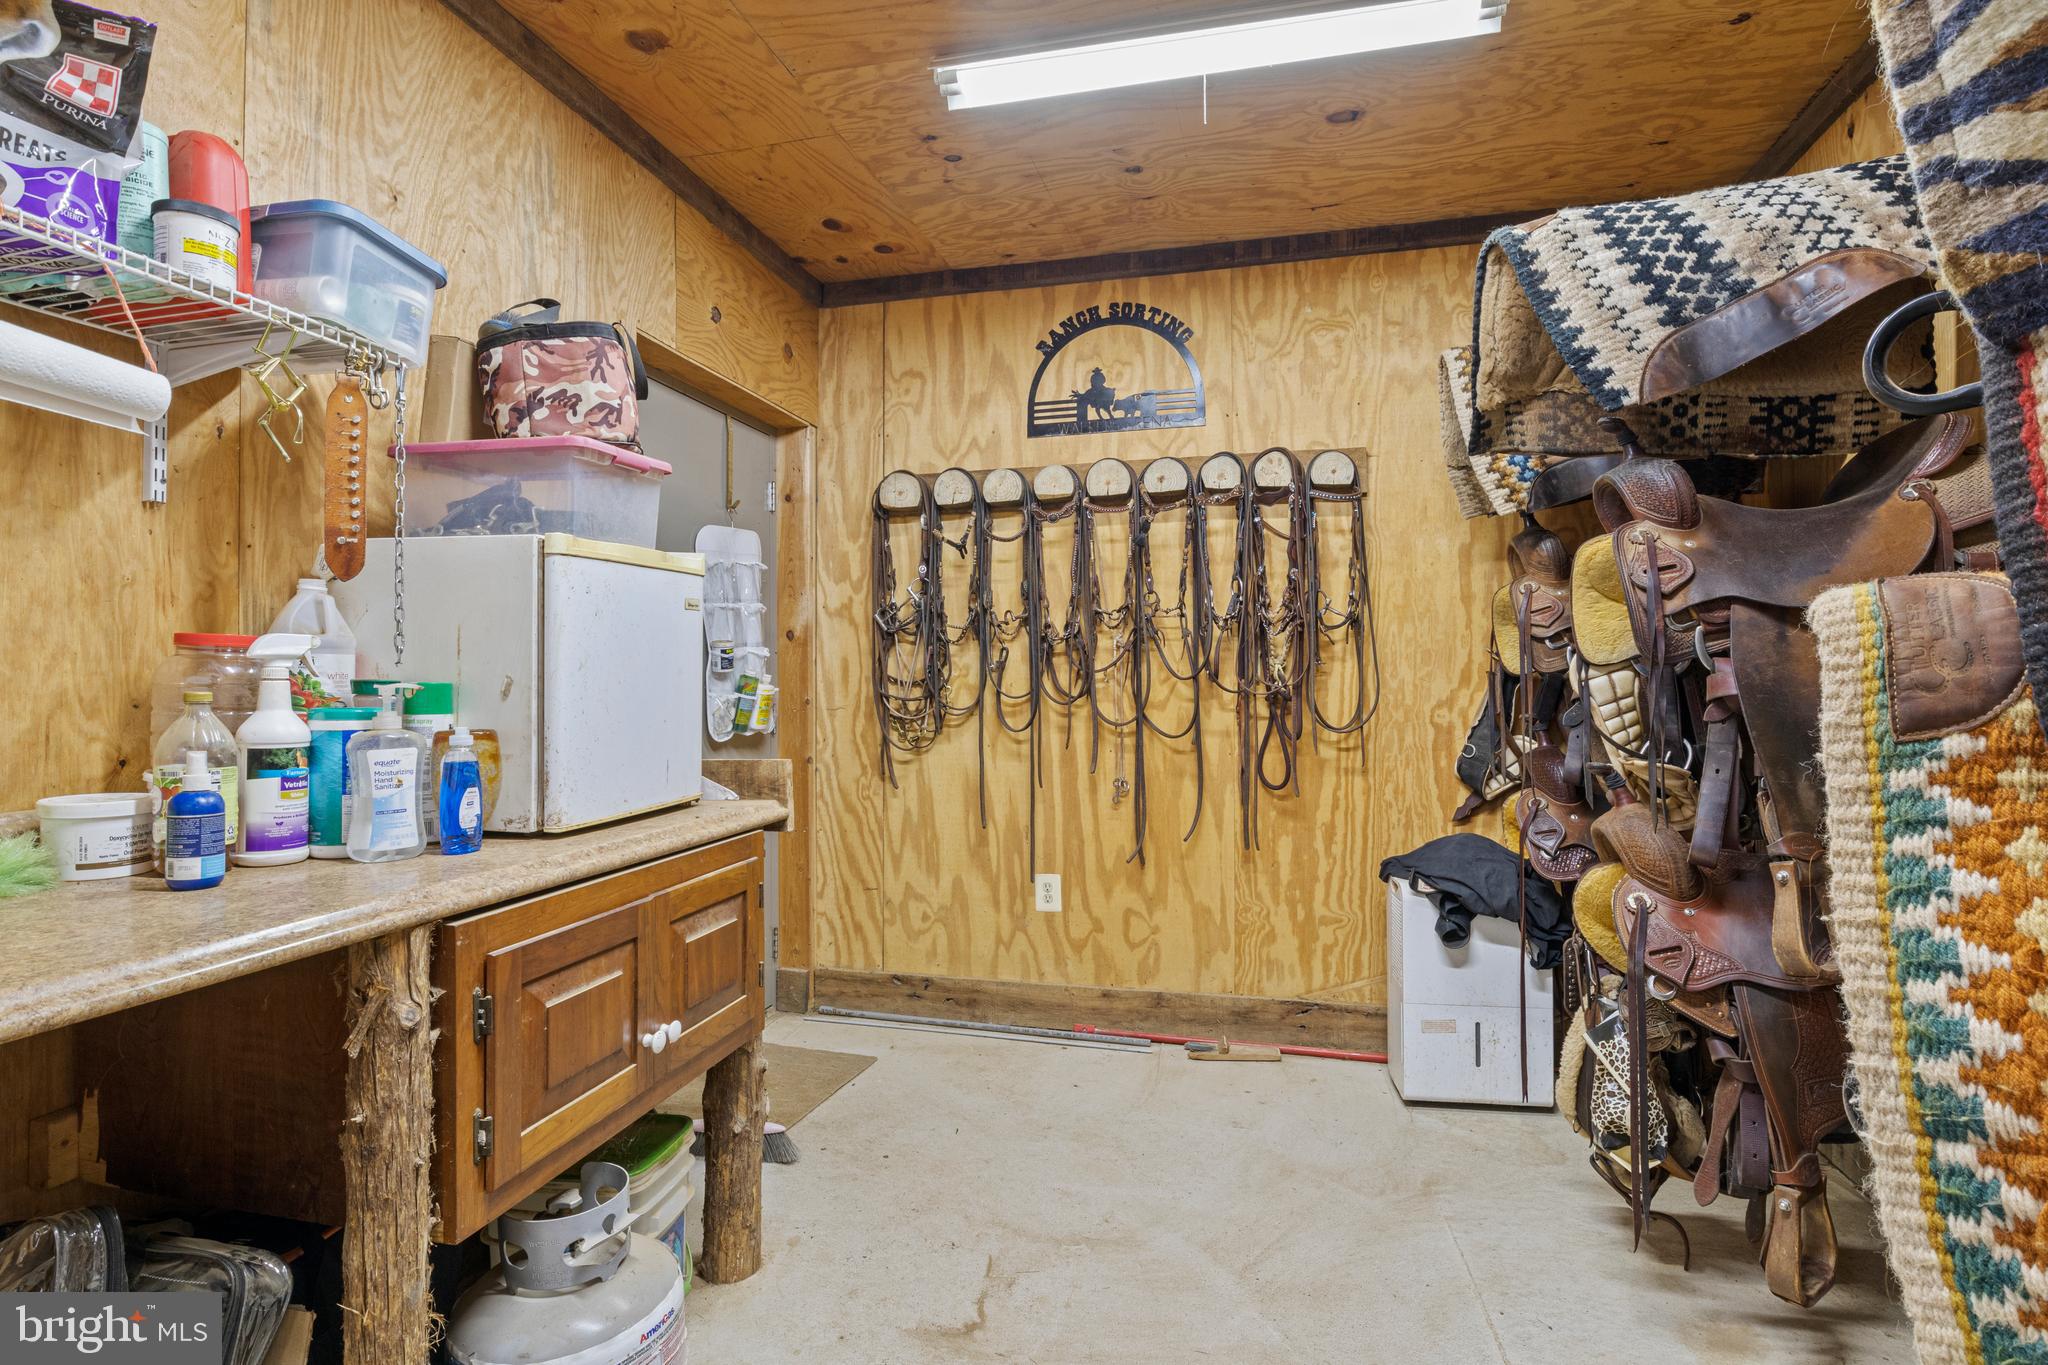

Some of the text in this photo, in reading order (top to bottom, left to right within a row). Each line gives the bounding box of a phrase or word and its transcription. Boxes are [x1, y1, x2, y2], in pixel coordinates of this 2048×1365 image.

[40, 91, 108, 131] PURINA
[60, 210, 85, 224] SCIENCE
[1036, 302, 1194, 357] RANCH SORTING
[327, 672, 349, 680] white
[374, 769, 414, 777] Moisturizing
[639, 1307, 675, 1345] AmeriGas
